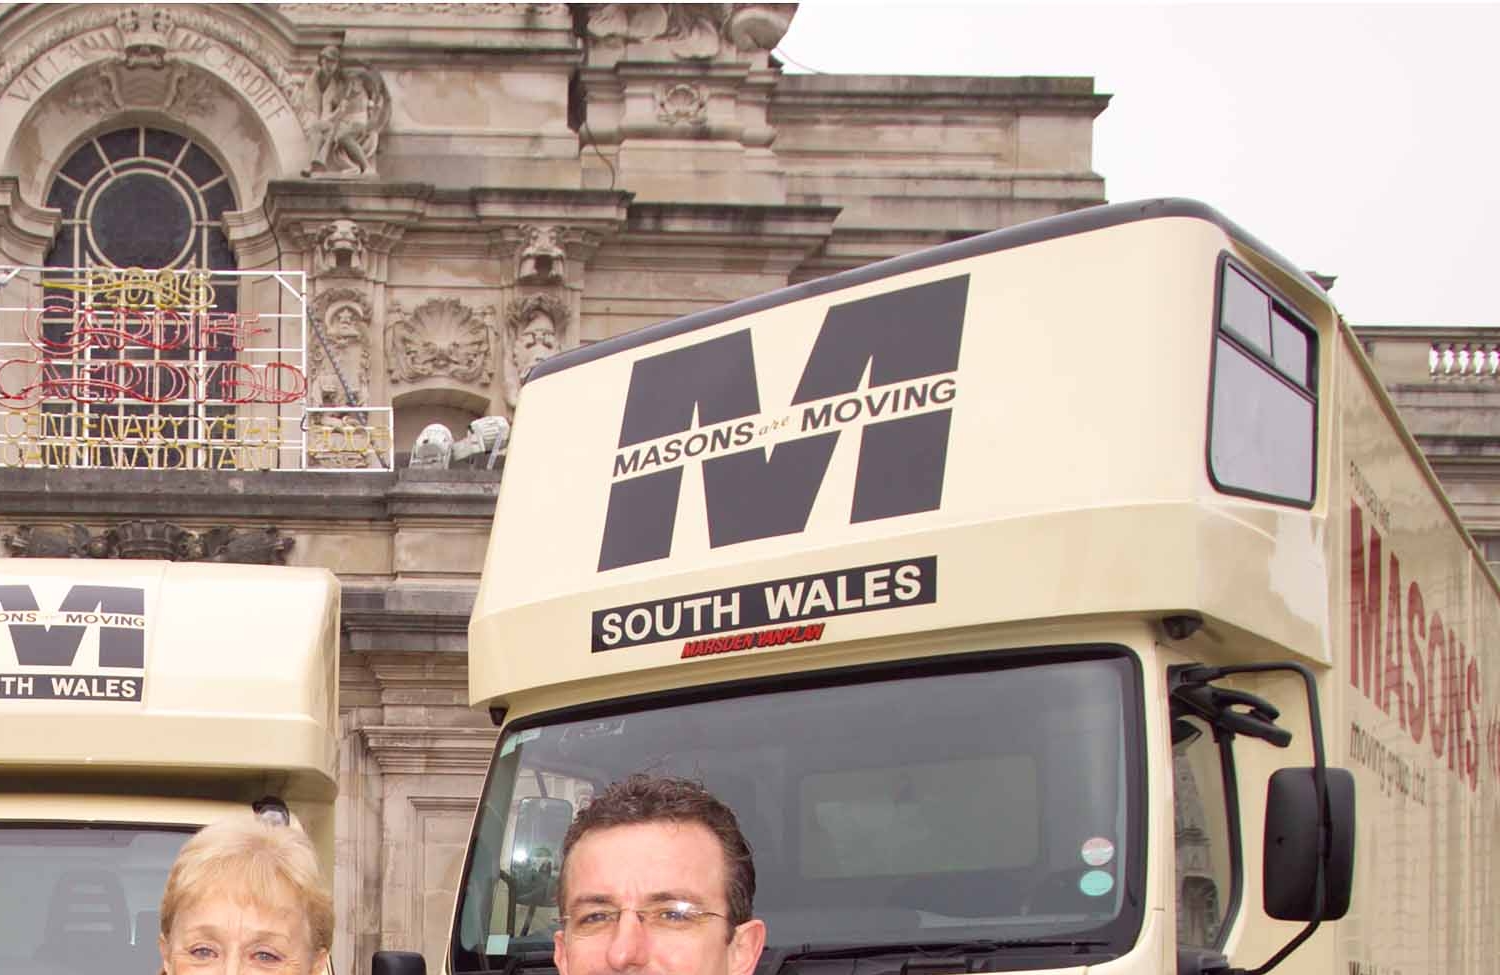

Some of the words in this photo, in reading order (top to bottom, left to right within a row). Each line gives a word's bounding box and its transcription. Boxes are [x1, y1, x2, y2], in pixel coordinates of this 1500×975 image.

[8, 44, 87, 103] VILLA
[203, 46, 287, 122] CARDIFF
[23, 296, 271, 357] CARDIFF
[3, 411, 183, 442] CENTENARY
[203, 413, 282, 446] YEAR
[612, 420, 755, 478] MASONS
[757, 414, 790, 437] are
[800, 378, 957, 432] MOVING
[65, 613, 145, 627] MOVING
[601, 591, 741, 645] SOUTH
[763, 563, 922, 620] WALES
[681, 632, 753, 659] MARSDEN
[756, 622, 826, 648] VANPLAN
[1350, 497, 1480, 793] MASONS
[51, 676, 136, 698] WALES
